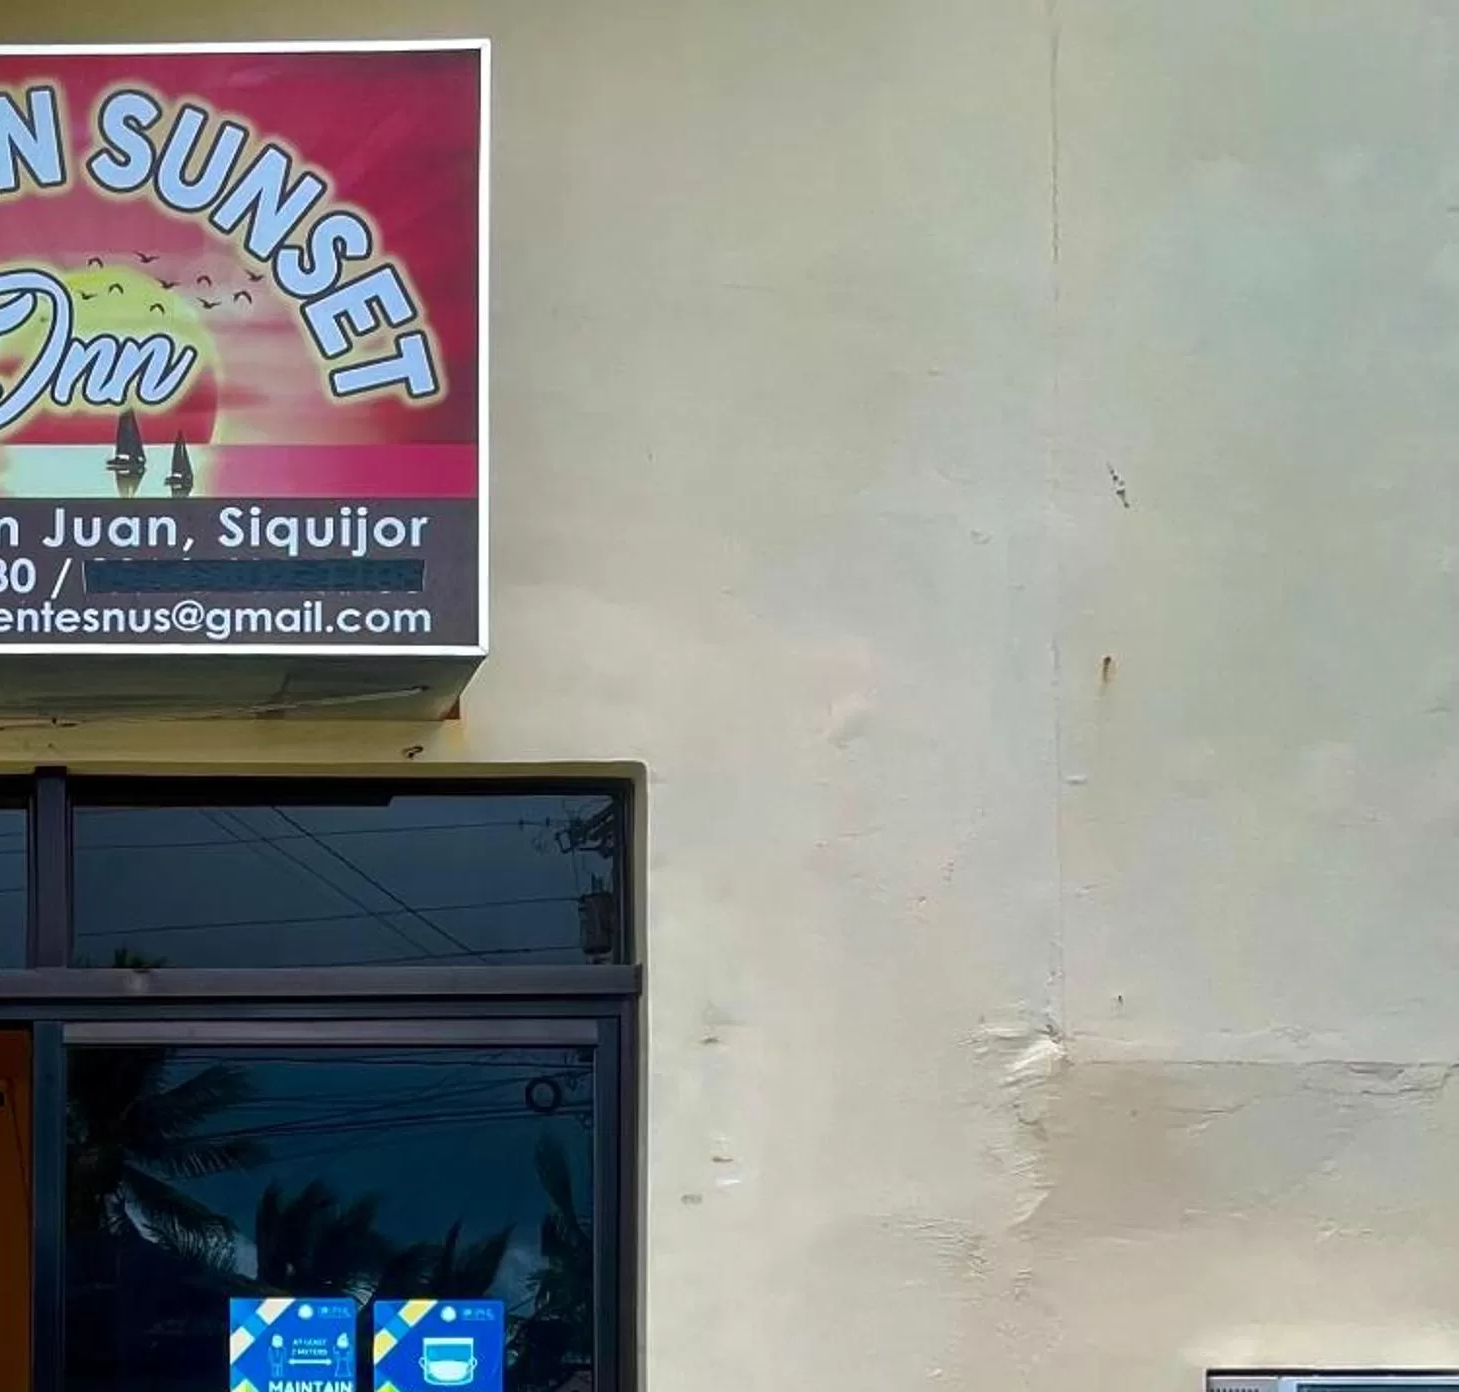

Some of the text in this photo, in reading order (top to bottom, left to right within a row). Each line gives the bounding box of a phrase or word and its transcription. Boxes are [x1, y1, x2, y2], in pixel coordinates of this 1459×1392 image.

[87, 88, 441, 401] SUNSET
[42, 507, 194, 552] Juan,
[218, 506, 429, 557] Siquijor
